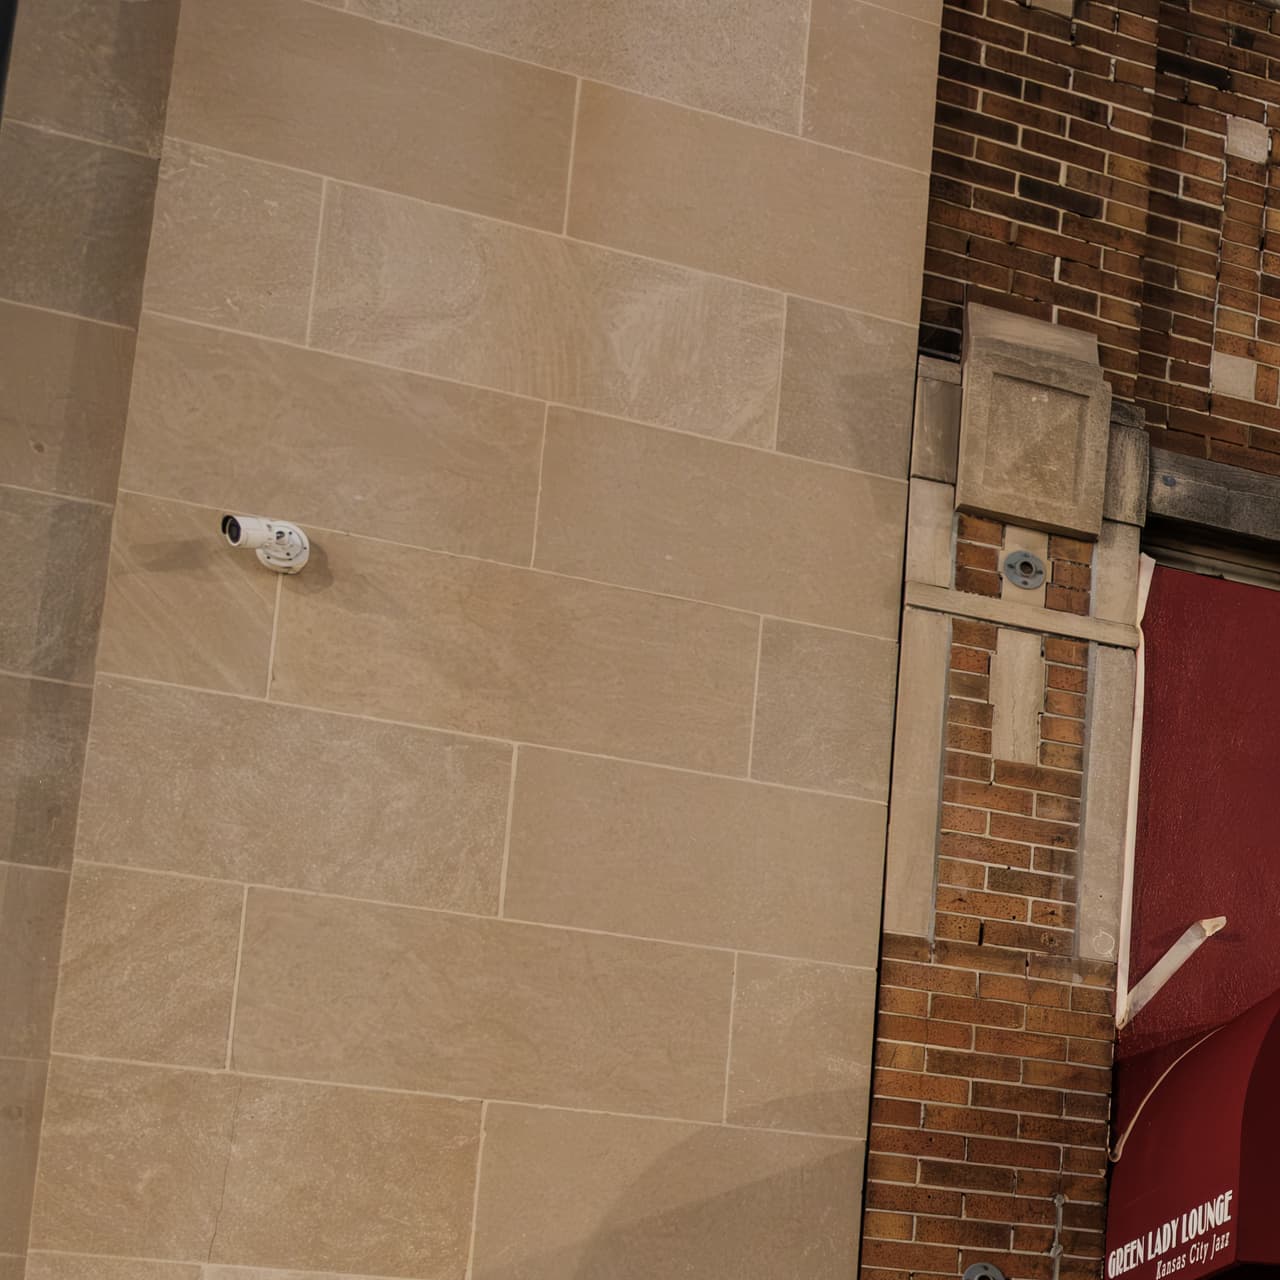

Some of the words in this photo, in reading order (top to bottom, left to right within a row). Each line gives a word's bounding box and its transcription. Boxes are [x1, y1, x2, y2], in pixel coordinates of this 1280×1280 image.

[1107, 1235, 1145, 1280] GREEN
[1147, 1217, 1180, 1261] LADY
[1181, 1189, 1232, 1244] LOUNGE
[1155, 1253, 1187, 1280] Kansas
[1189, 1241, 1209, 1264] City
[1210, 1231, 1230, 1260] Jazz
